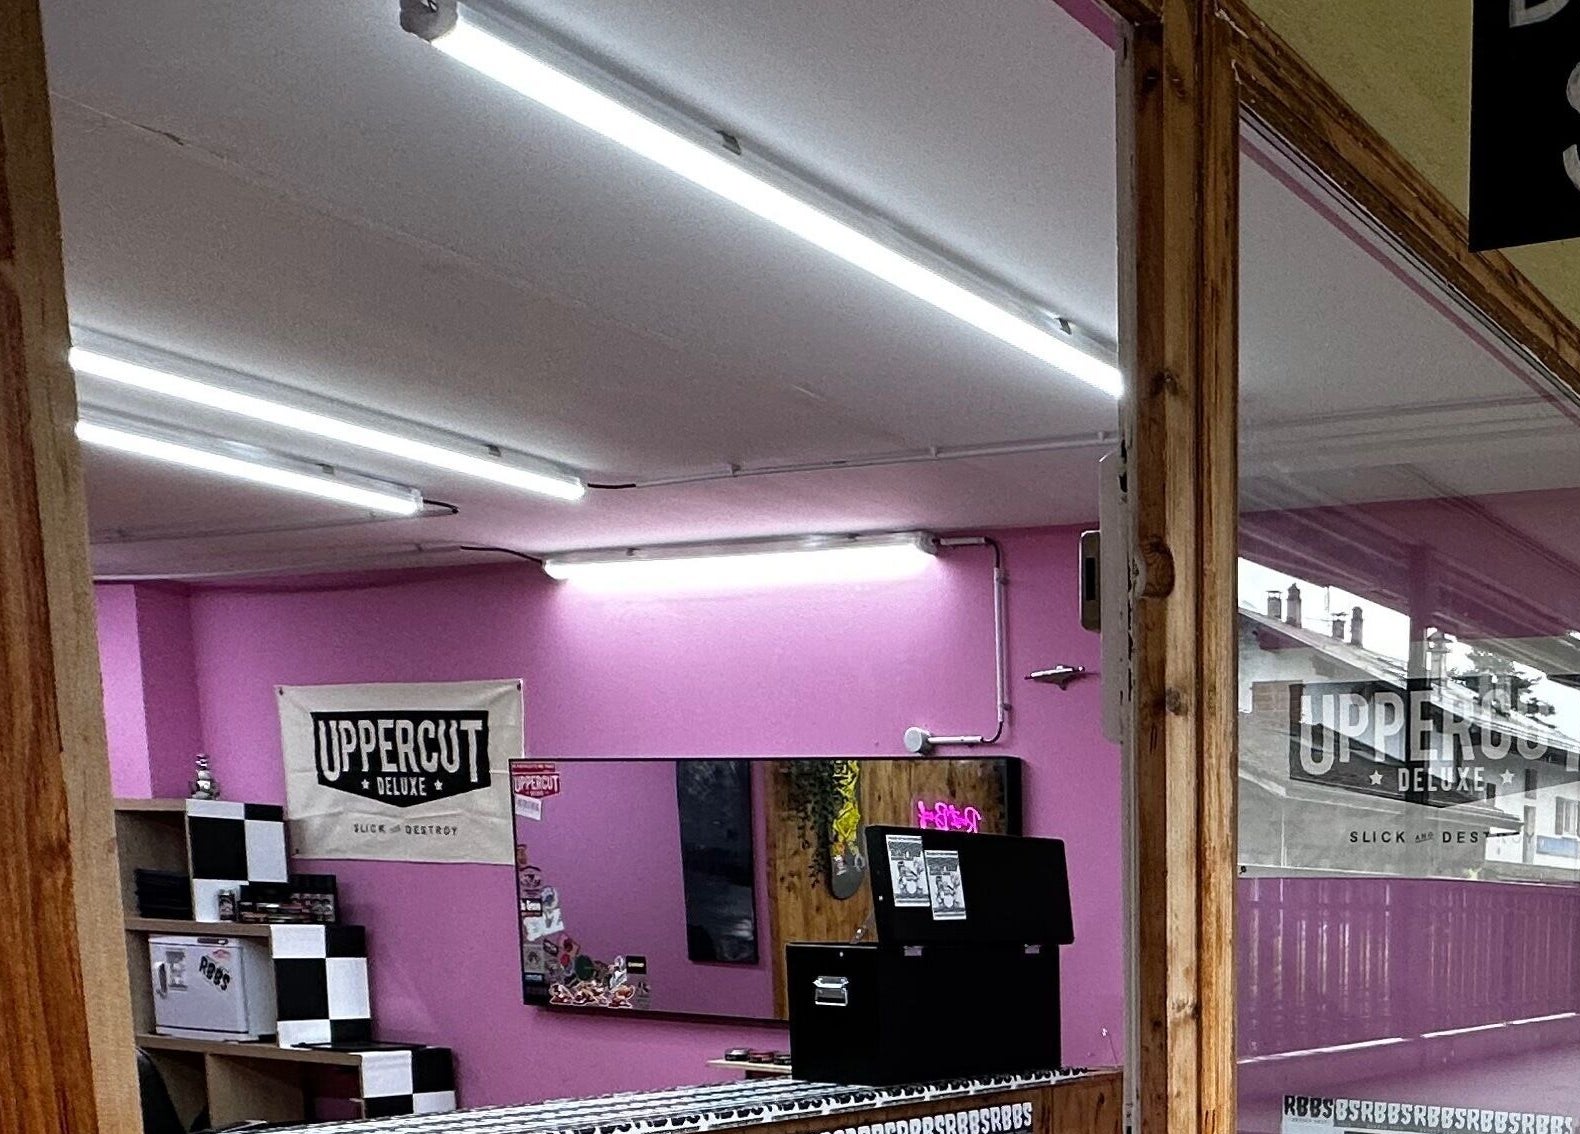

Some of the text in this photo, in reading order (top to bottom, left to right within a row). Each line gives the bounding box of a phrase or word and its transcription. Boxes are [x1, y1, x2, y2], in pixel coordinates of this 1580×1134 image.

[318, 720, 483, 782] UPPERCUT
[377, 776, 428, 797] DELUXE
[1398, 767, 1485, 792] DELUXE
[354, 823, 386, 834] SLICK
[405, 825, 458, 836] DESTROY
[1350, 831, 1406, 844] SLICK
[1284, 1094, 1334, 1118] RBBS
